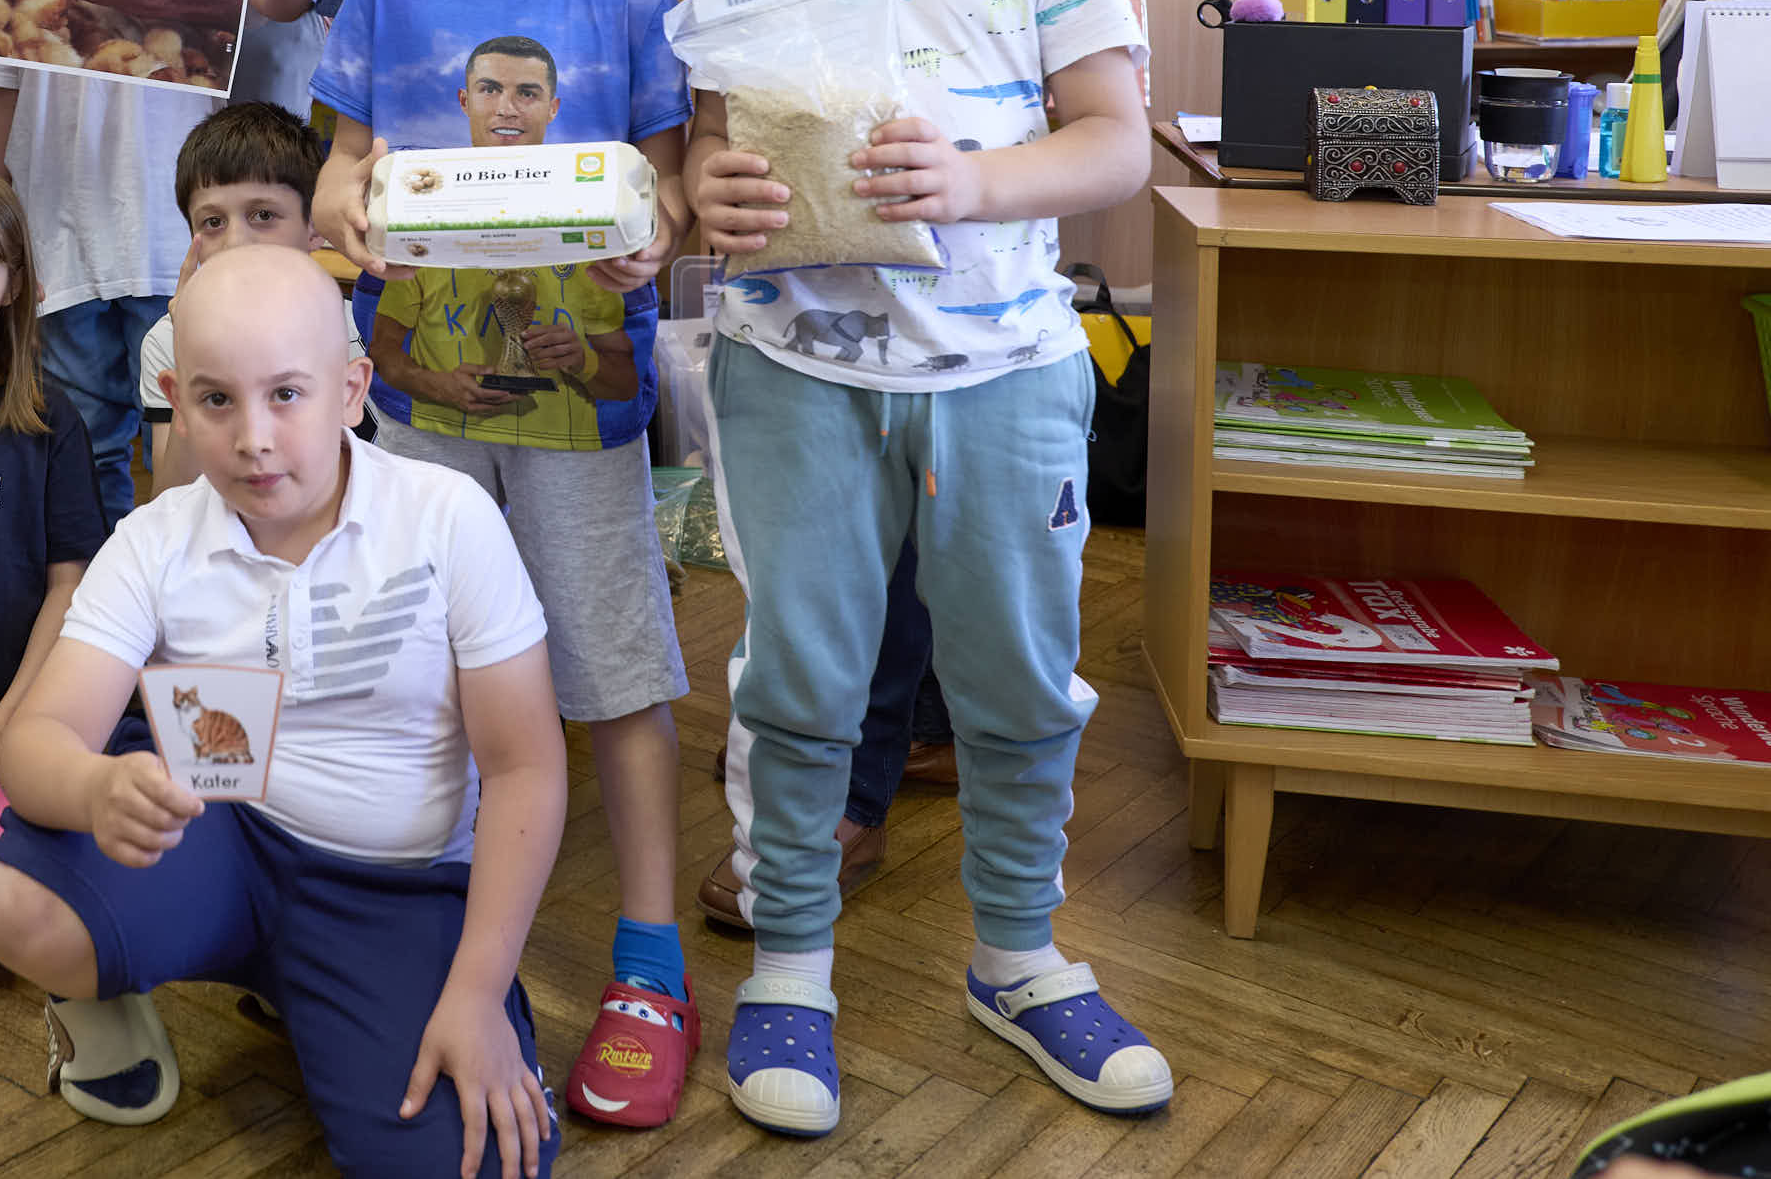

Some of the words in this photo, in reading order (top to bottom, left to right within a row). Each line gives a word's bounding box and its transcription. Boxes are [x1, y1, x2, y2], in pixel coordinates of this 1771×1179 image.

[454, 171, 473, 182] 10
[477, 168, 552, 182] Bio-Eier
[1347, 580, 1408, 621] Trax
[190, 774, 241, 790] Kater
